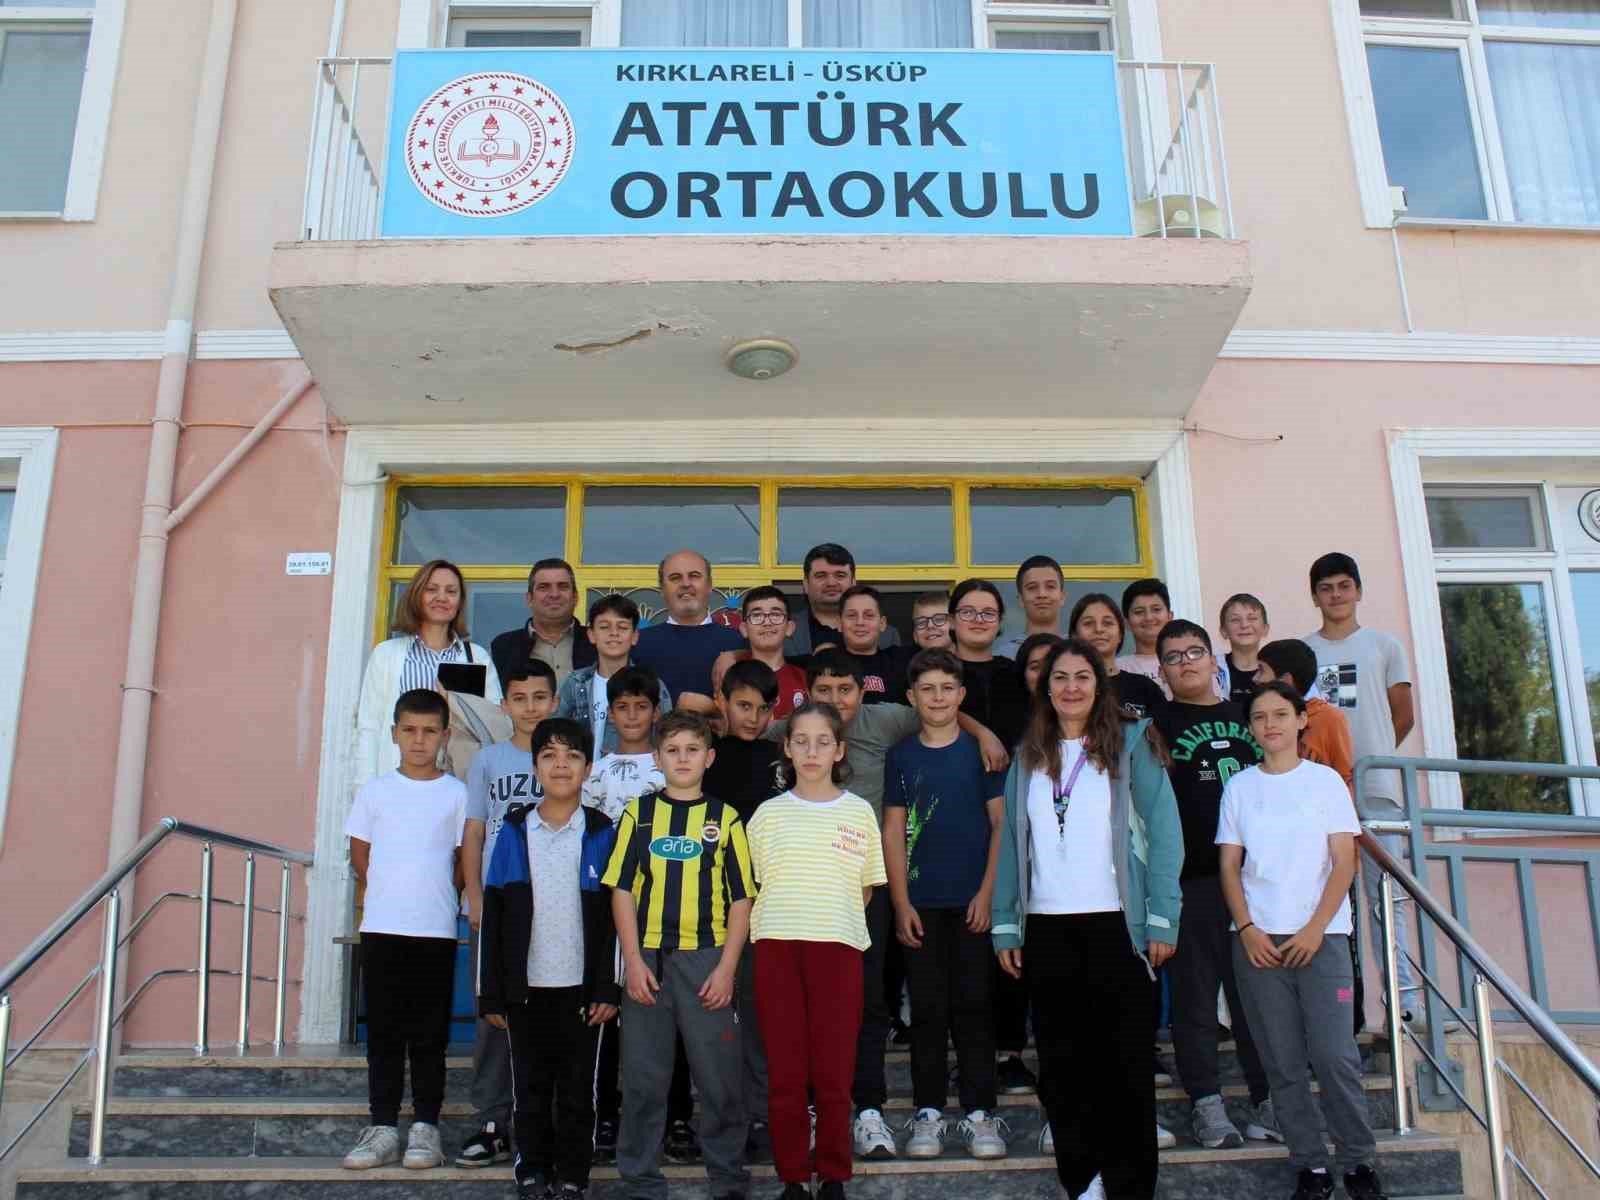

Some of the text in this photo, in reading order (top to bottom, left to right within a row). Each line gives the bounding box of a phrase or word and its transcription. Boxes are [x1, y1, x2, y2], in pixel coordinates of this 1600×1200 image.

[616, 60, 795, 82] KIRKLARELİ
[821, 60, 928, 82] ÜSKÜP
[610, 90, 968, 146] ATATÜRK
[609, 170, 1100, 219] ORTAOKULU
[661, 838, 695, 854] aria
